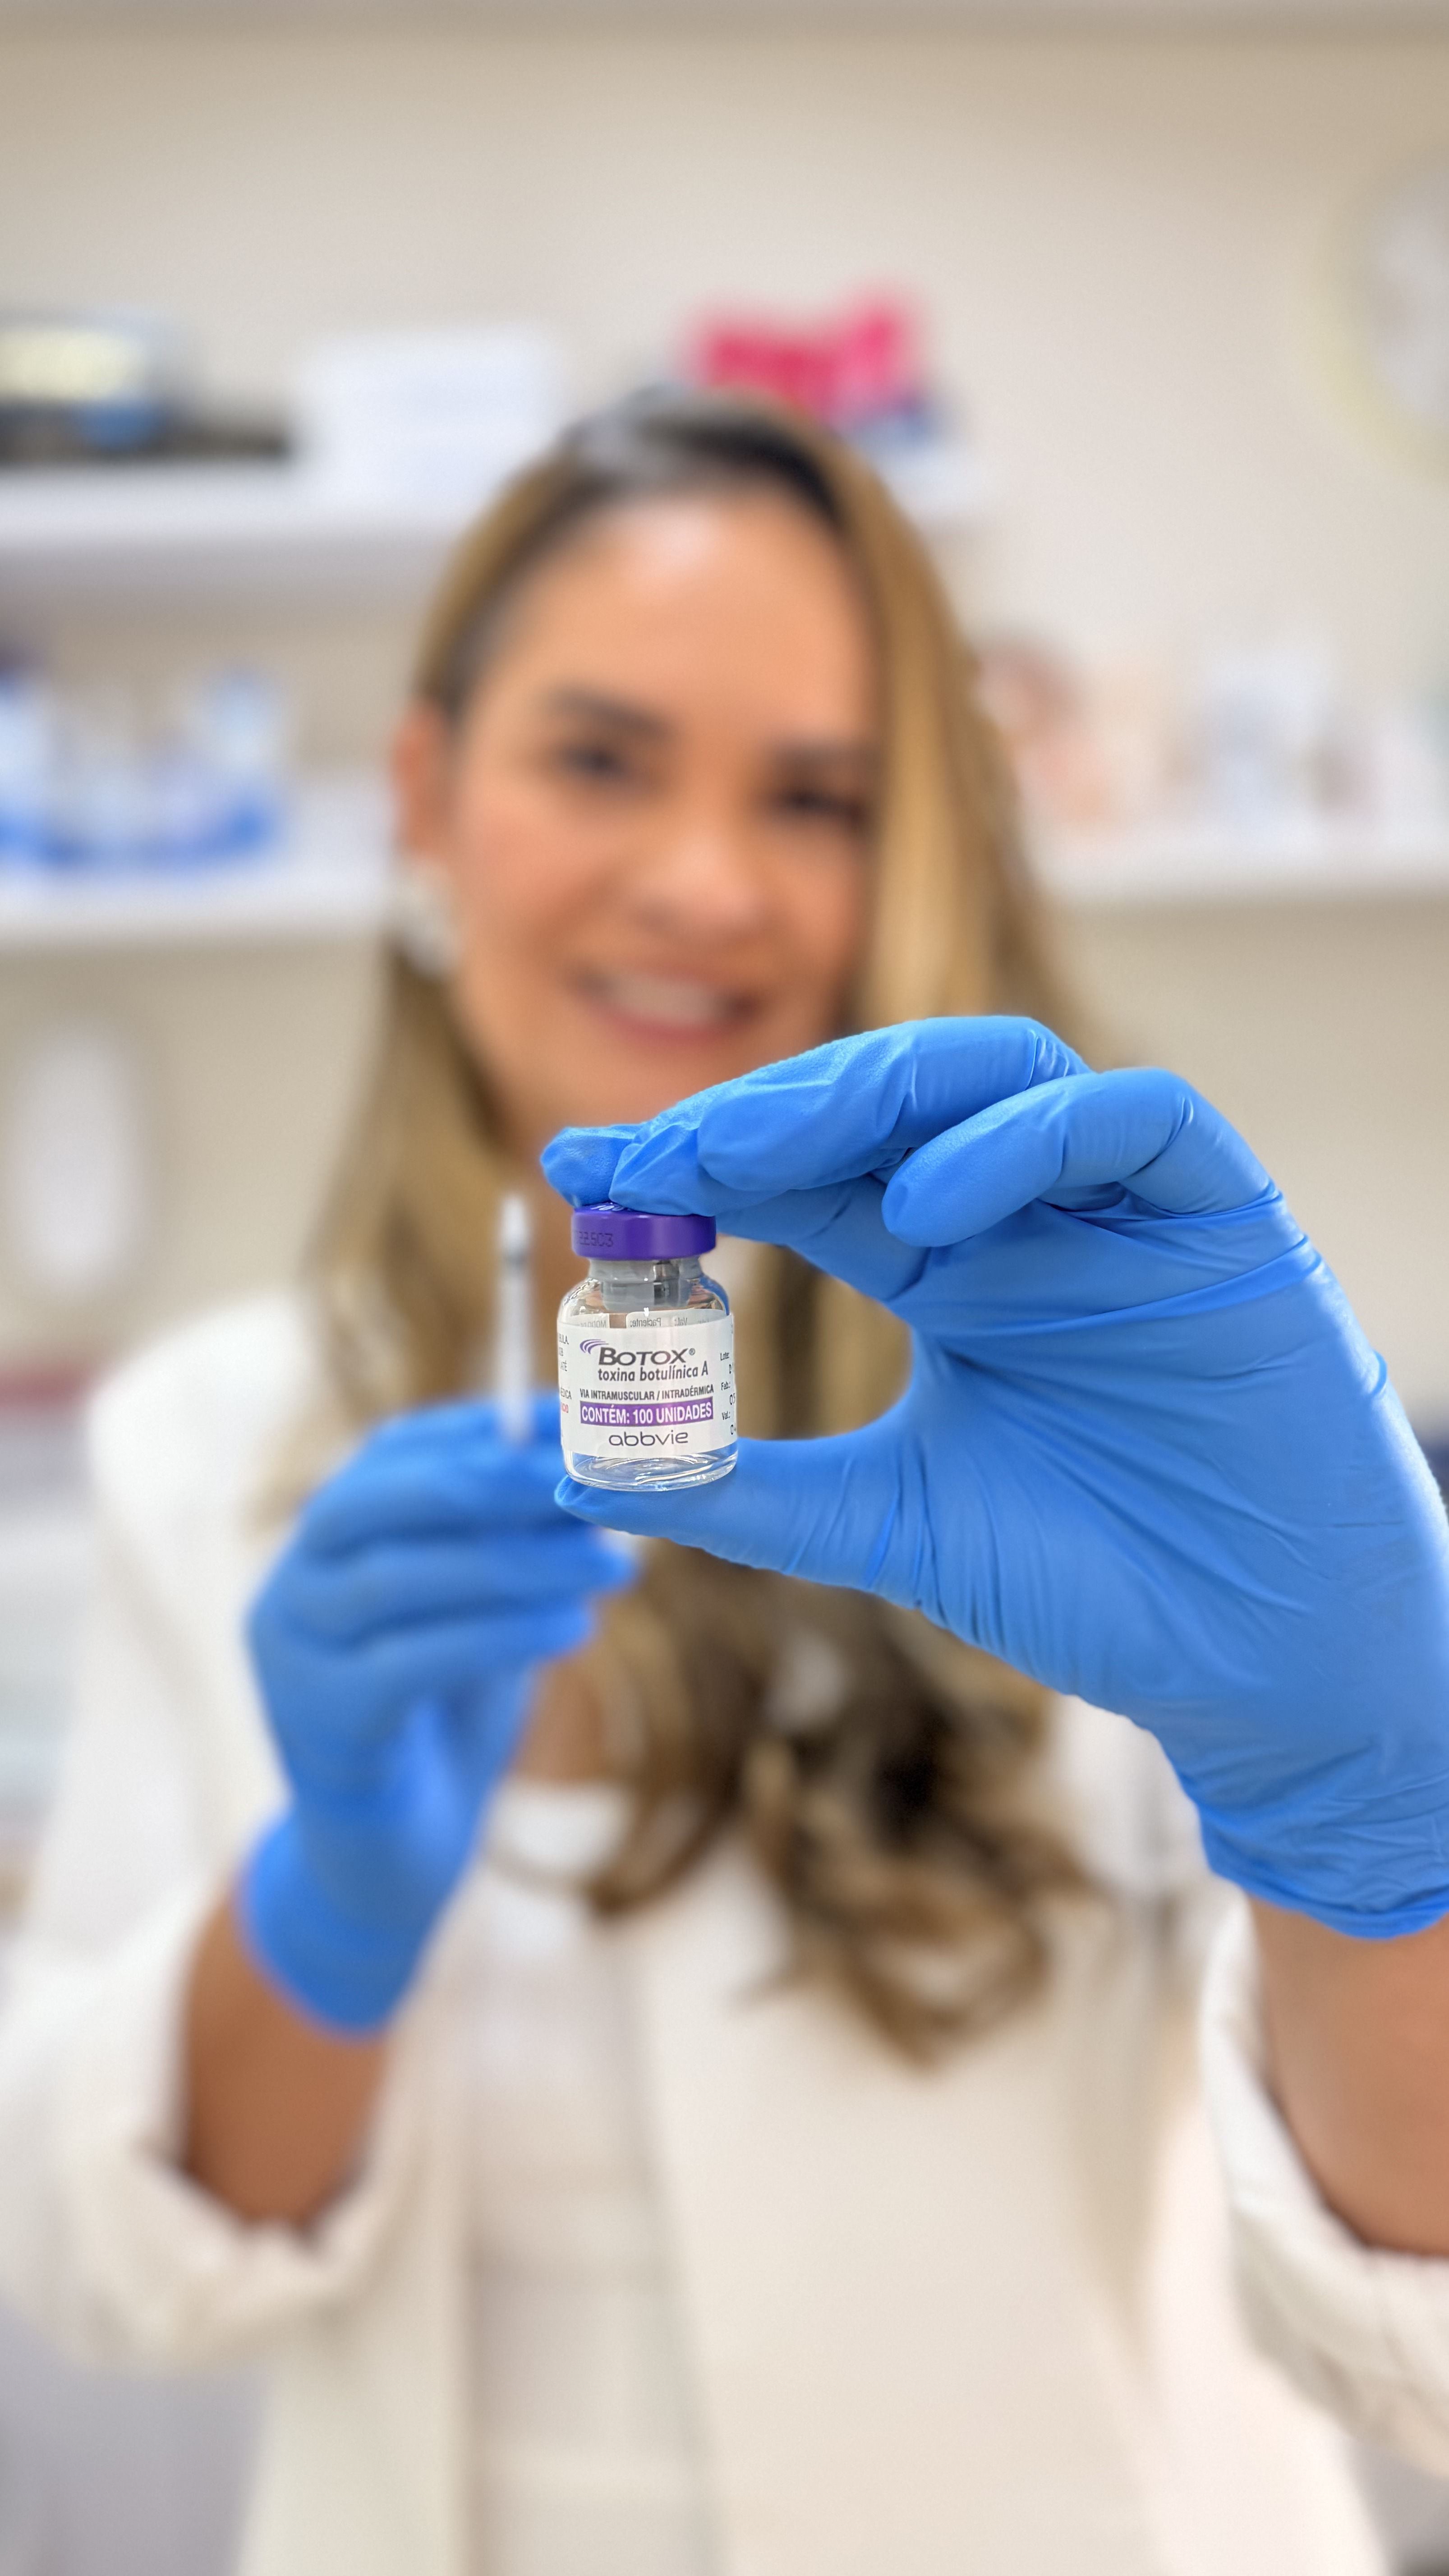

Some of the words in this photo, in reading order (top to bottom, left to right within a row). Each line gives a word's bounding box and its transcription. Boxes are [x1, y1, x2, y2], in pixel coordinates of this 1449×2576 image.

[598, 1367, 635, 1381] toxina
[639, 1365, 699, 1381] botulínica
[701, 1360, 708, 1375] A
[580, 1388, 590, 1398] VIA
[591, 1389, 655, 1401] INTRAMUSCULAR
[656, 1390, 660, 1401] /
[662, 1384, 714, 1399] INTRADÉRMICA
[581, 1404, 630, 1424] CONTÉM:
[633, 1408, 653, 1424] 100
[656, 1402, 712, 1424] UNIDADES
[608, 1430, 689, 1446] abbvie
